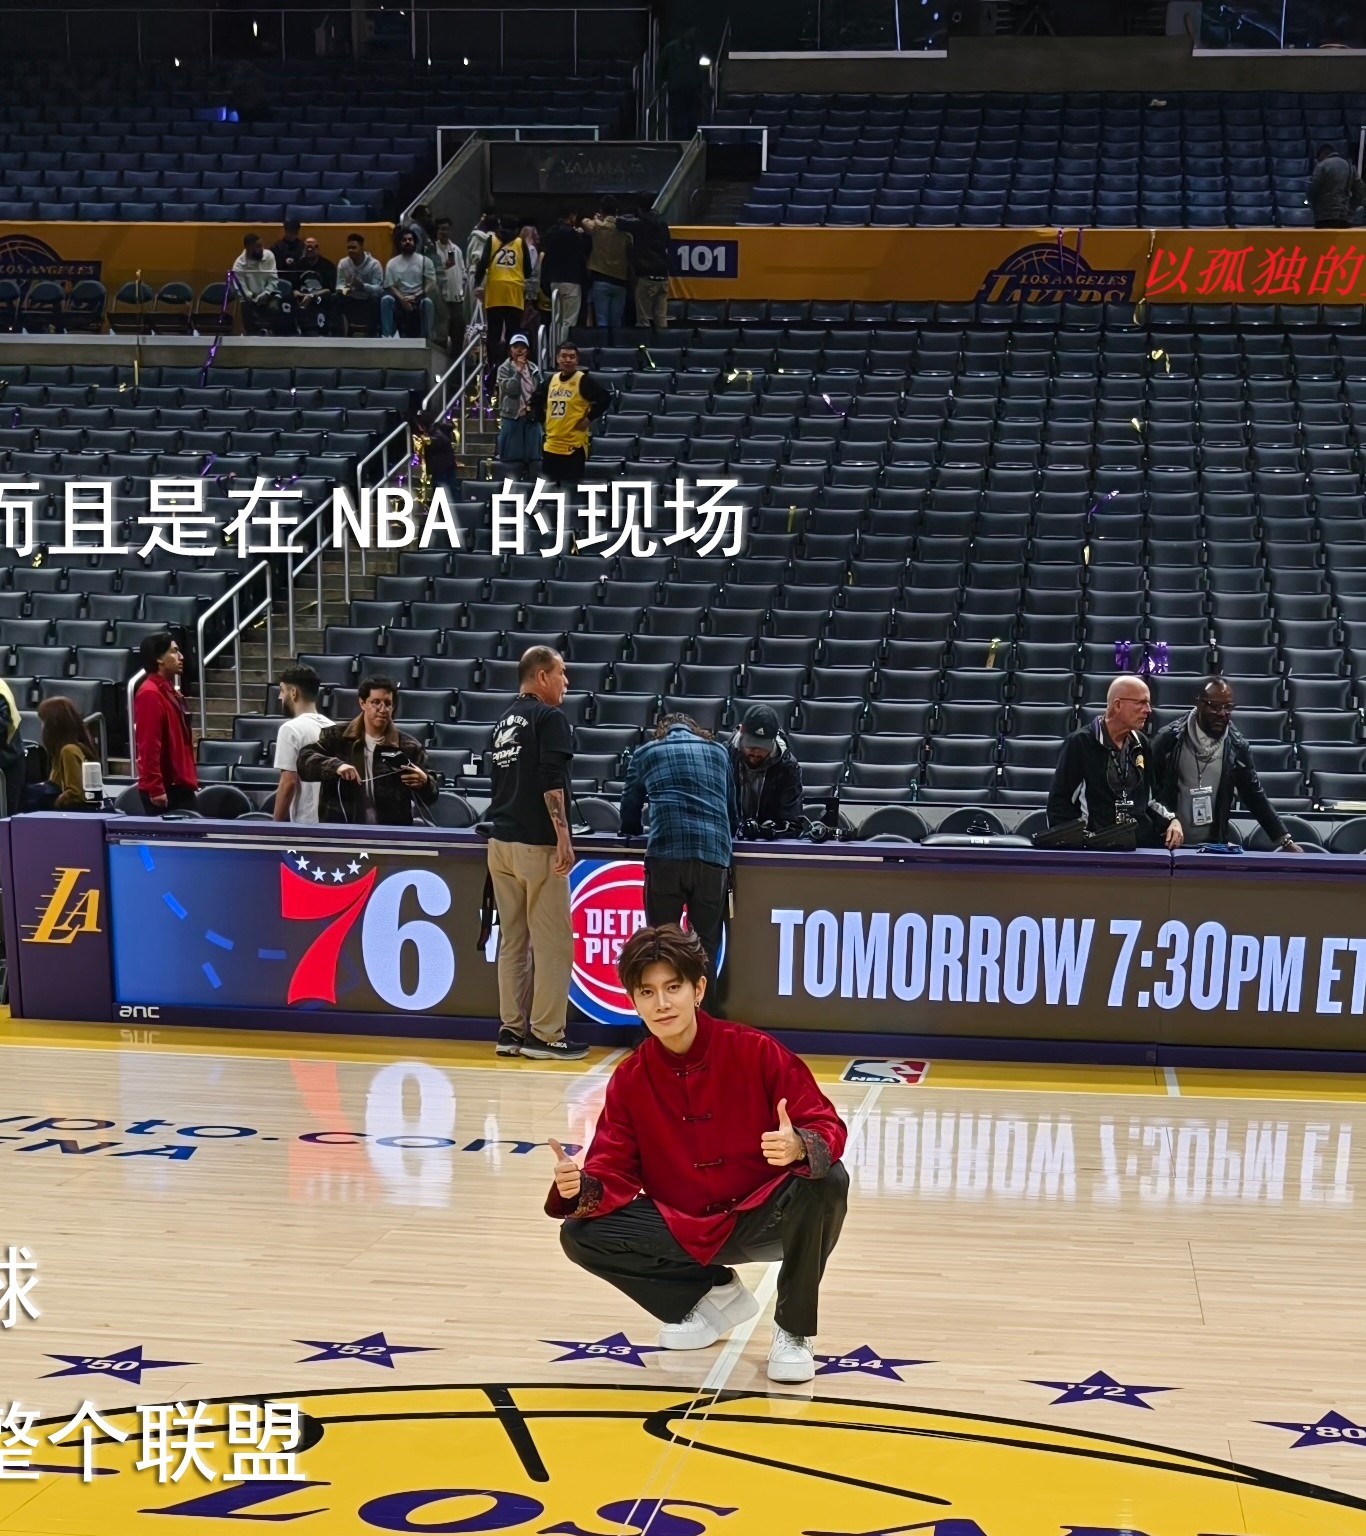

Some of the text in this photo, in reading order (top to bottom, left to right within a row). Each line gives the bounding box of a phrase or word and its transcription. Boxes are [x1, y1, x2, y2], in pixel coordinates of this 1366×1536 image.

[676, 245, 726, 272] 101
[550, 400, 567, 417] 23
[21, 867, 102, 944] LA
[584, 907, 648, 936] DETR
[280, 861, 456, 1012] 76
[770, 908, 1096, 1005] TOMORROW
[1107, 918, 1306, 1014] 7:30PM
[118, 1005, 161, 1019] anc
[331, 1343, 390, 1358] '52
[576, 1343, 634, 1358] '53
[80, 1357, 140, 1372] '50
[827, 1357, 886, 1371] '54
[1066, 1383, 1128, 1398] '72
